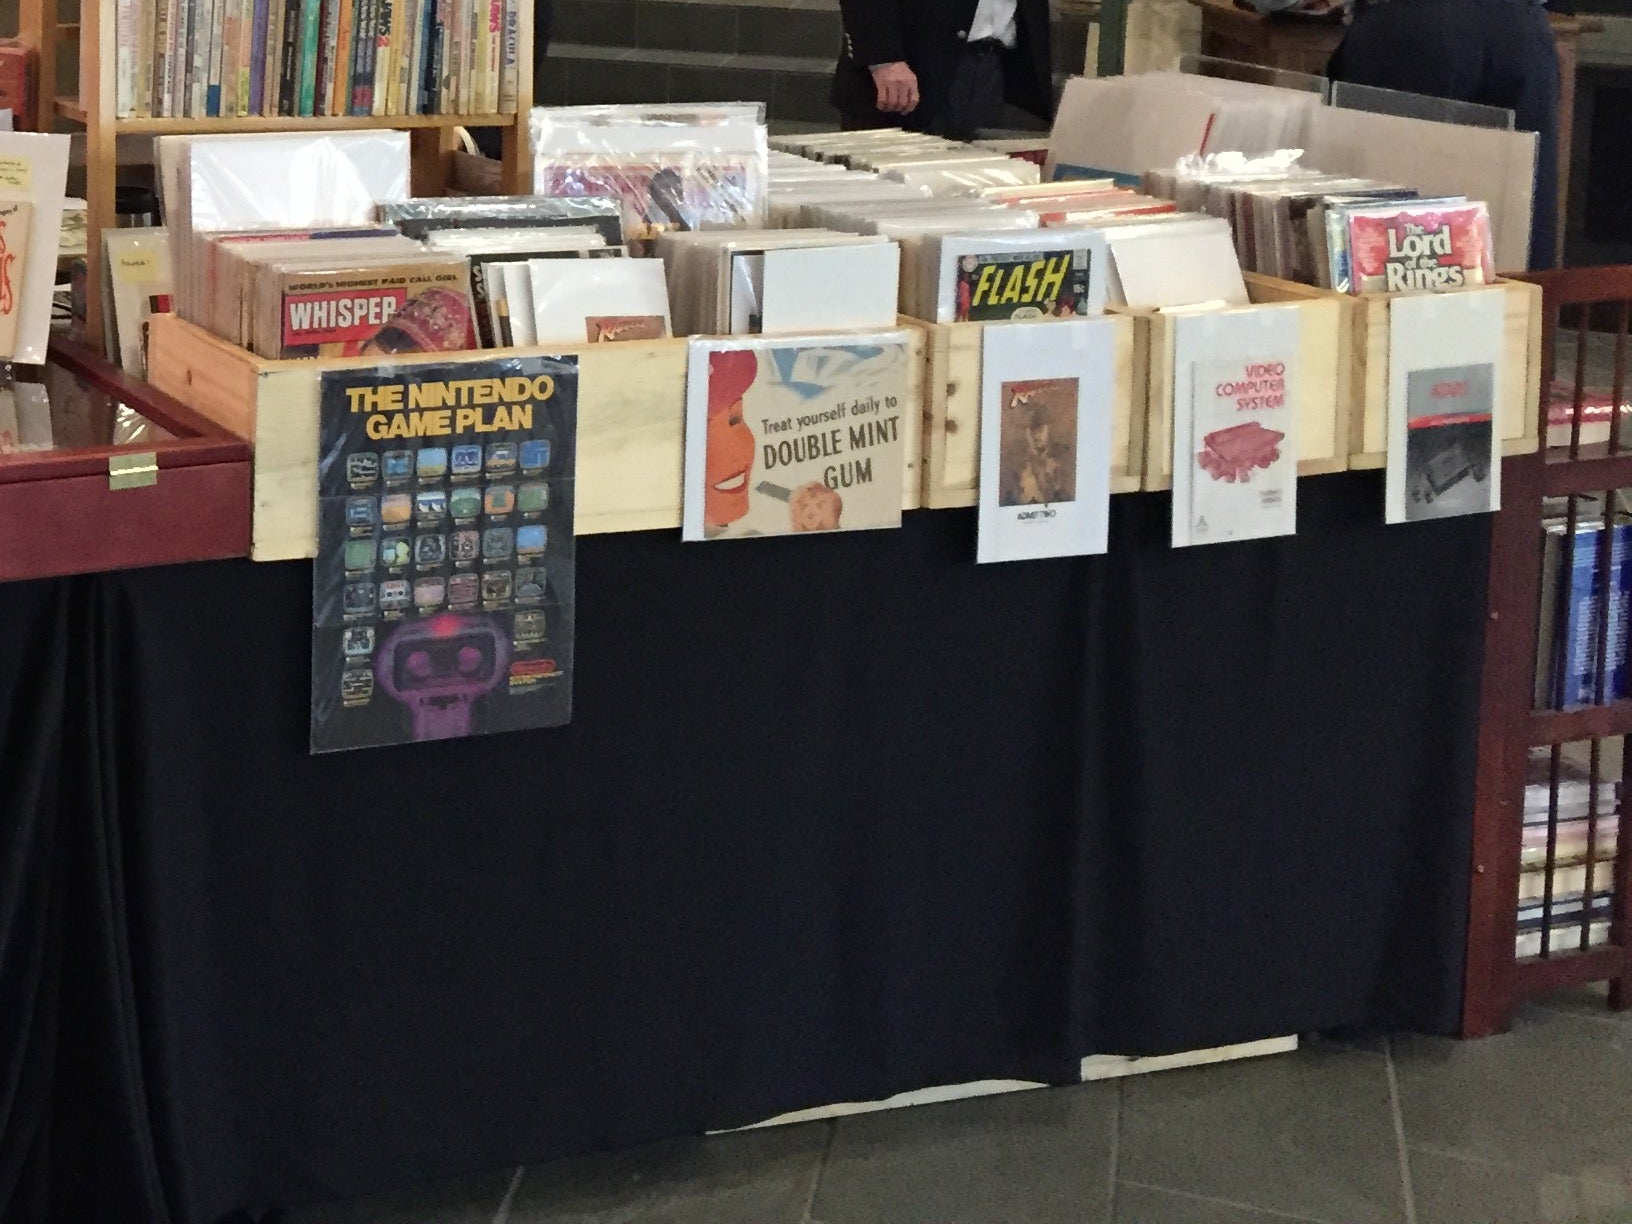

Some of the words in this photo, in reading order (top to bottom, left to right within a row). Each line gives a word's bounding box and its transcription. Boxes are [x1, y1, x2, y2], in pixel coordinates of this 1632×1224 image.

[376, 36, 390, 49] 2
[505, 11, 518, 65] DRACULA
[1387, 225, 1453, 257] Lord
[971, 254, 1071, 306] FLASH
[1386, 263, 1465, 292] Rings
[290, 296, 397, 331] WHISPER
[1245, 362, 1286, 377] VIDEO
[346, 383, 403, 413] THE
[408, 375, 555, 410] NINTENDO
[1216, 378, 1285, 397] COMPUTER
[1236, 394, 1285, 411] SYSTEM
[366, 411, 453, 440] GAME
[456, 404, 533, 434] PLAN
[762, 415, 793, 436] Treat
[796, 403, 847, 432] yourself
[851, 397, 882, 421] daily
[885, 394, 898, 410] to
[763, 426, 843, 471] DOUBLE
[849, 415, 900, 452] MINT
[824, 457, 873, 489] GUM
